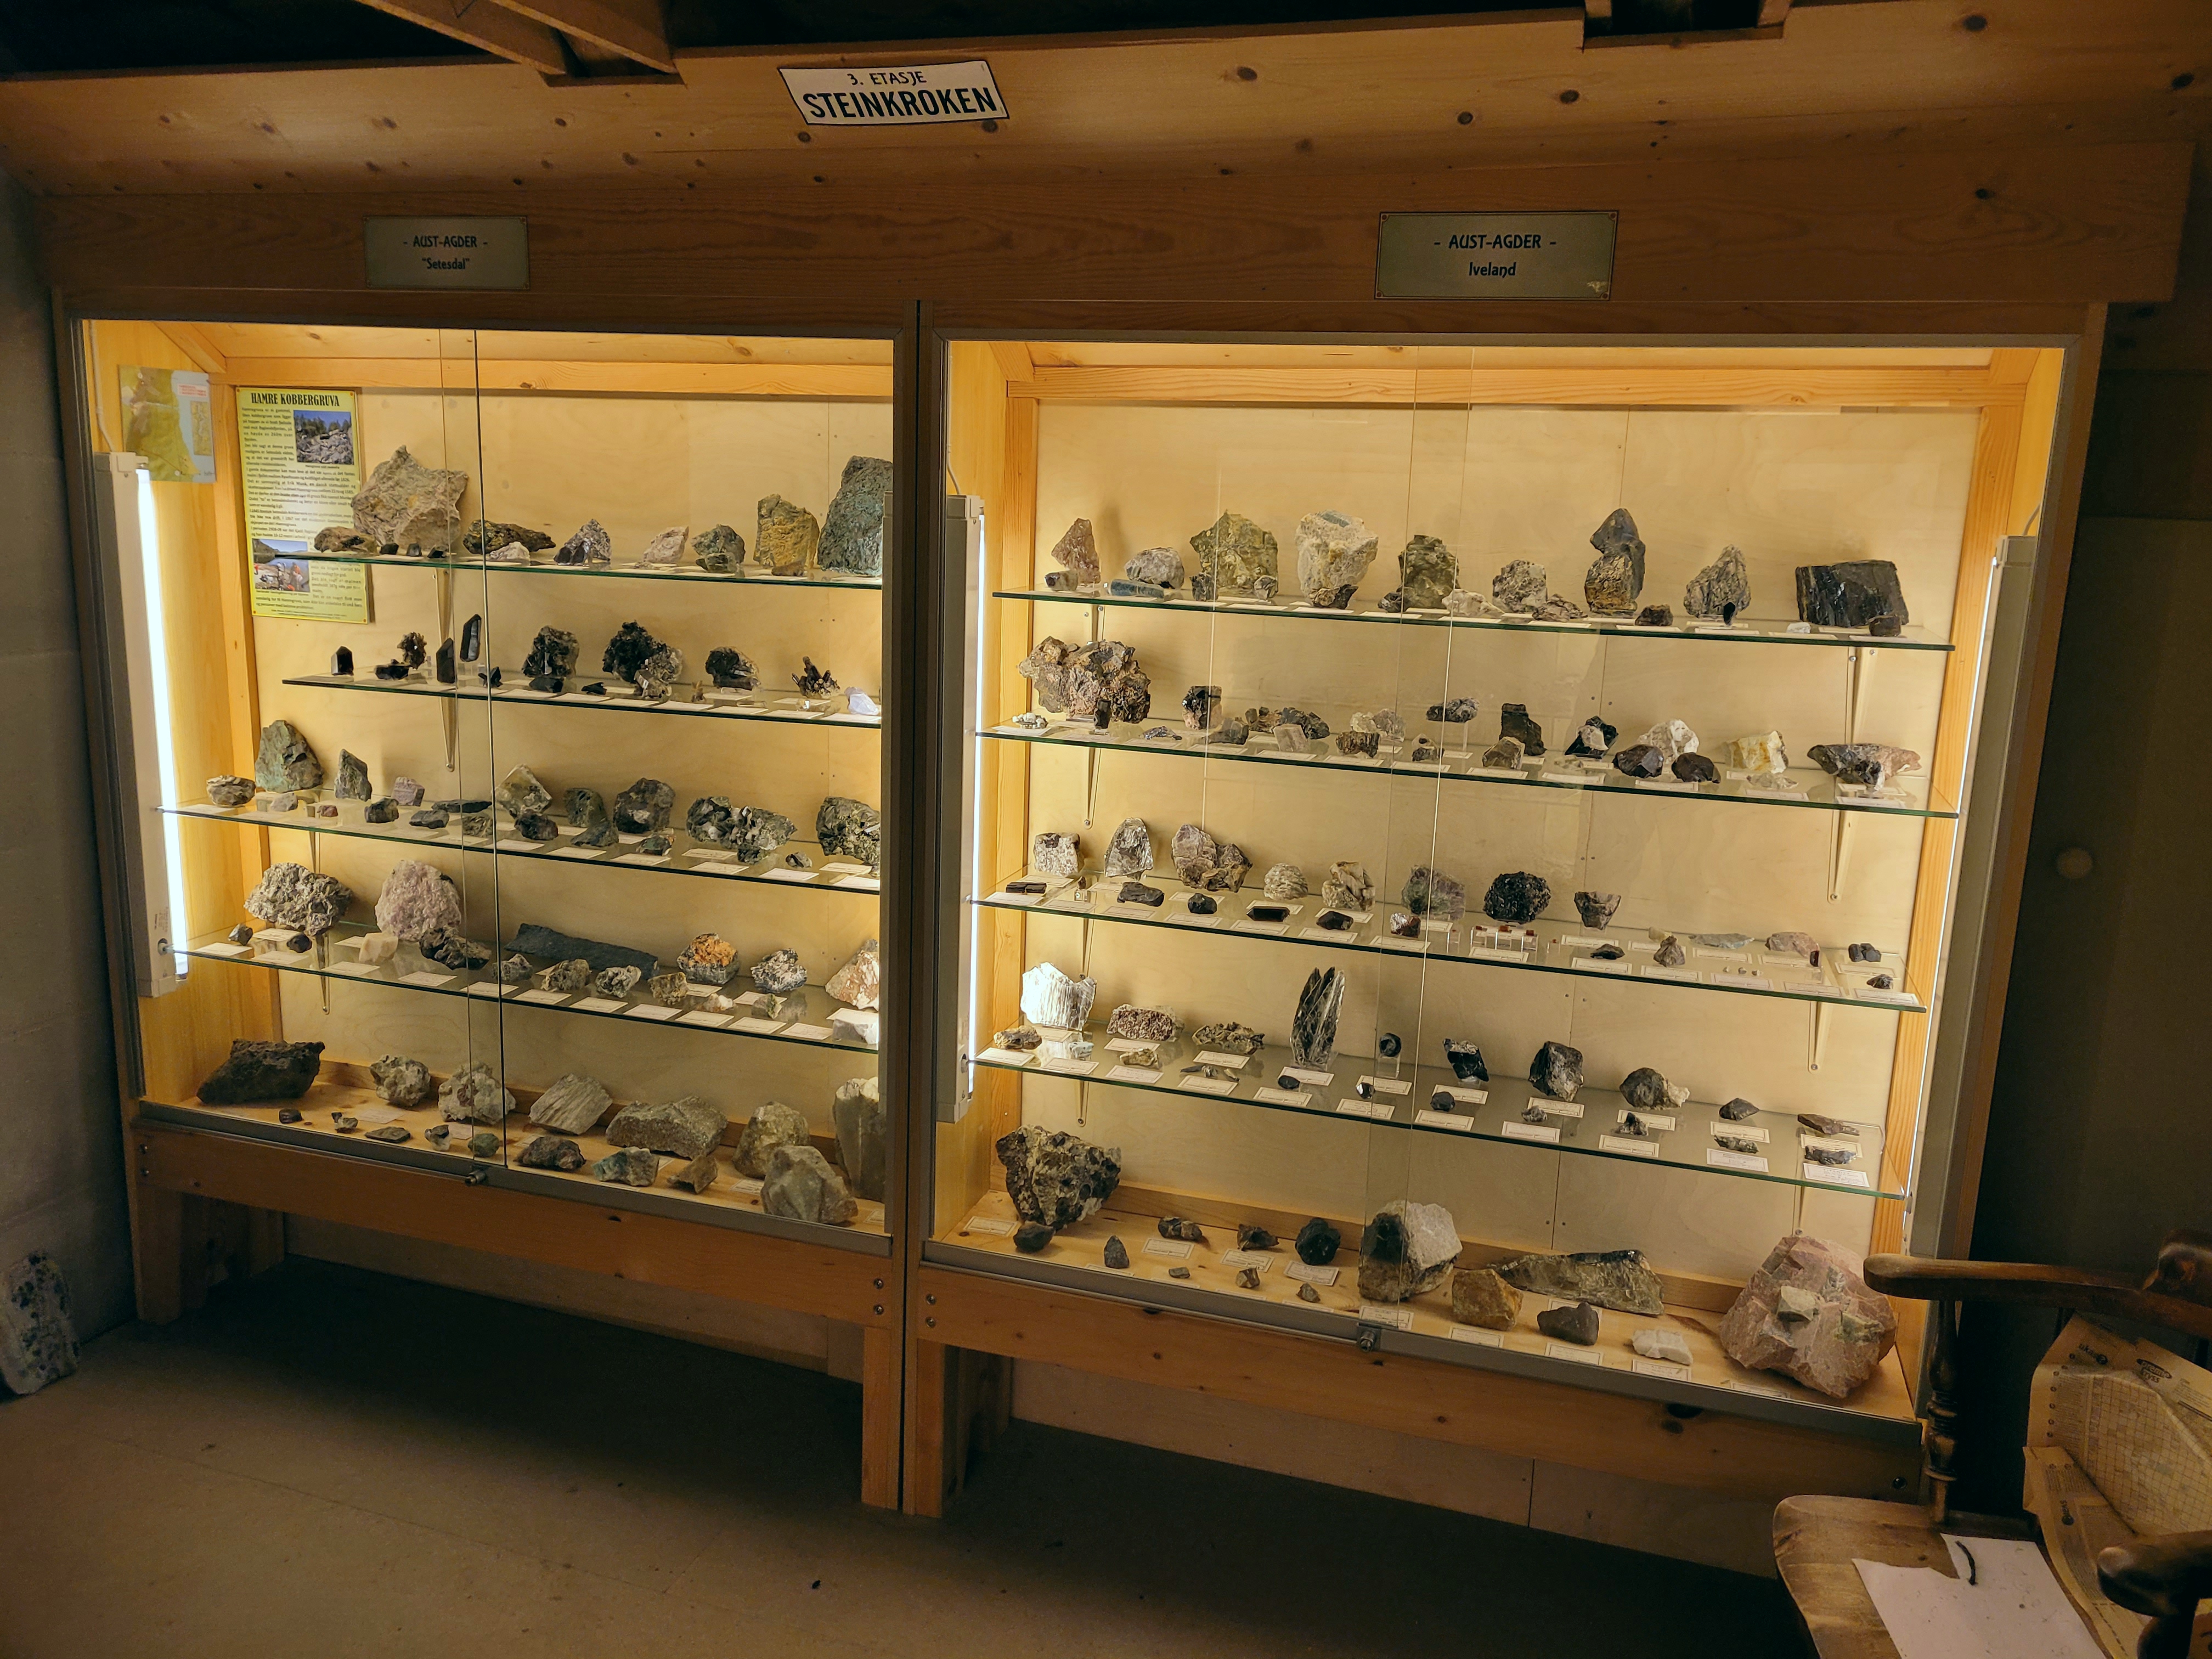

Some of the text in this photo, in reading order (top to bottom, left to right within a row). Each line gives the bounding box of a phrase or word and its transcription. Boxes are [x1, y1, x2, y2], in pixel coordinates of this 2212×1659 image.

[847, 71, 927, 87] 3. ETASJE
[803, 87, 997, 118] STEINKROKEN
[413, 235, 477, 247] AUST-AGDER
[1448, 234, 1542, 249] AUST-AGDER
[1469, 262, 1517, 279] Iveland
[251, 392, 340, 407] HAMRE KOBBERGRUVA
